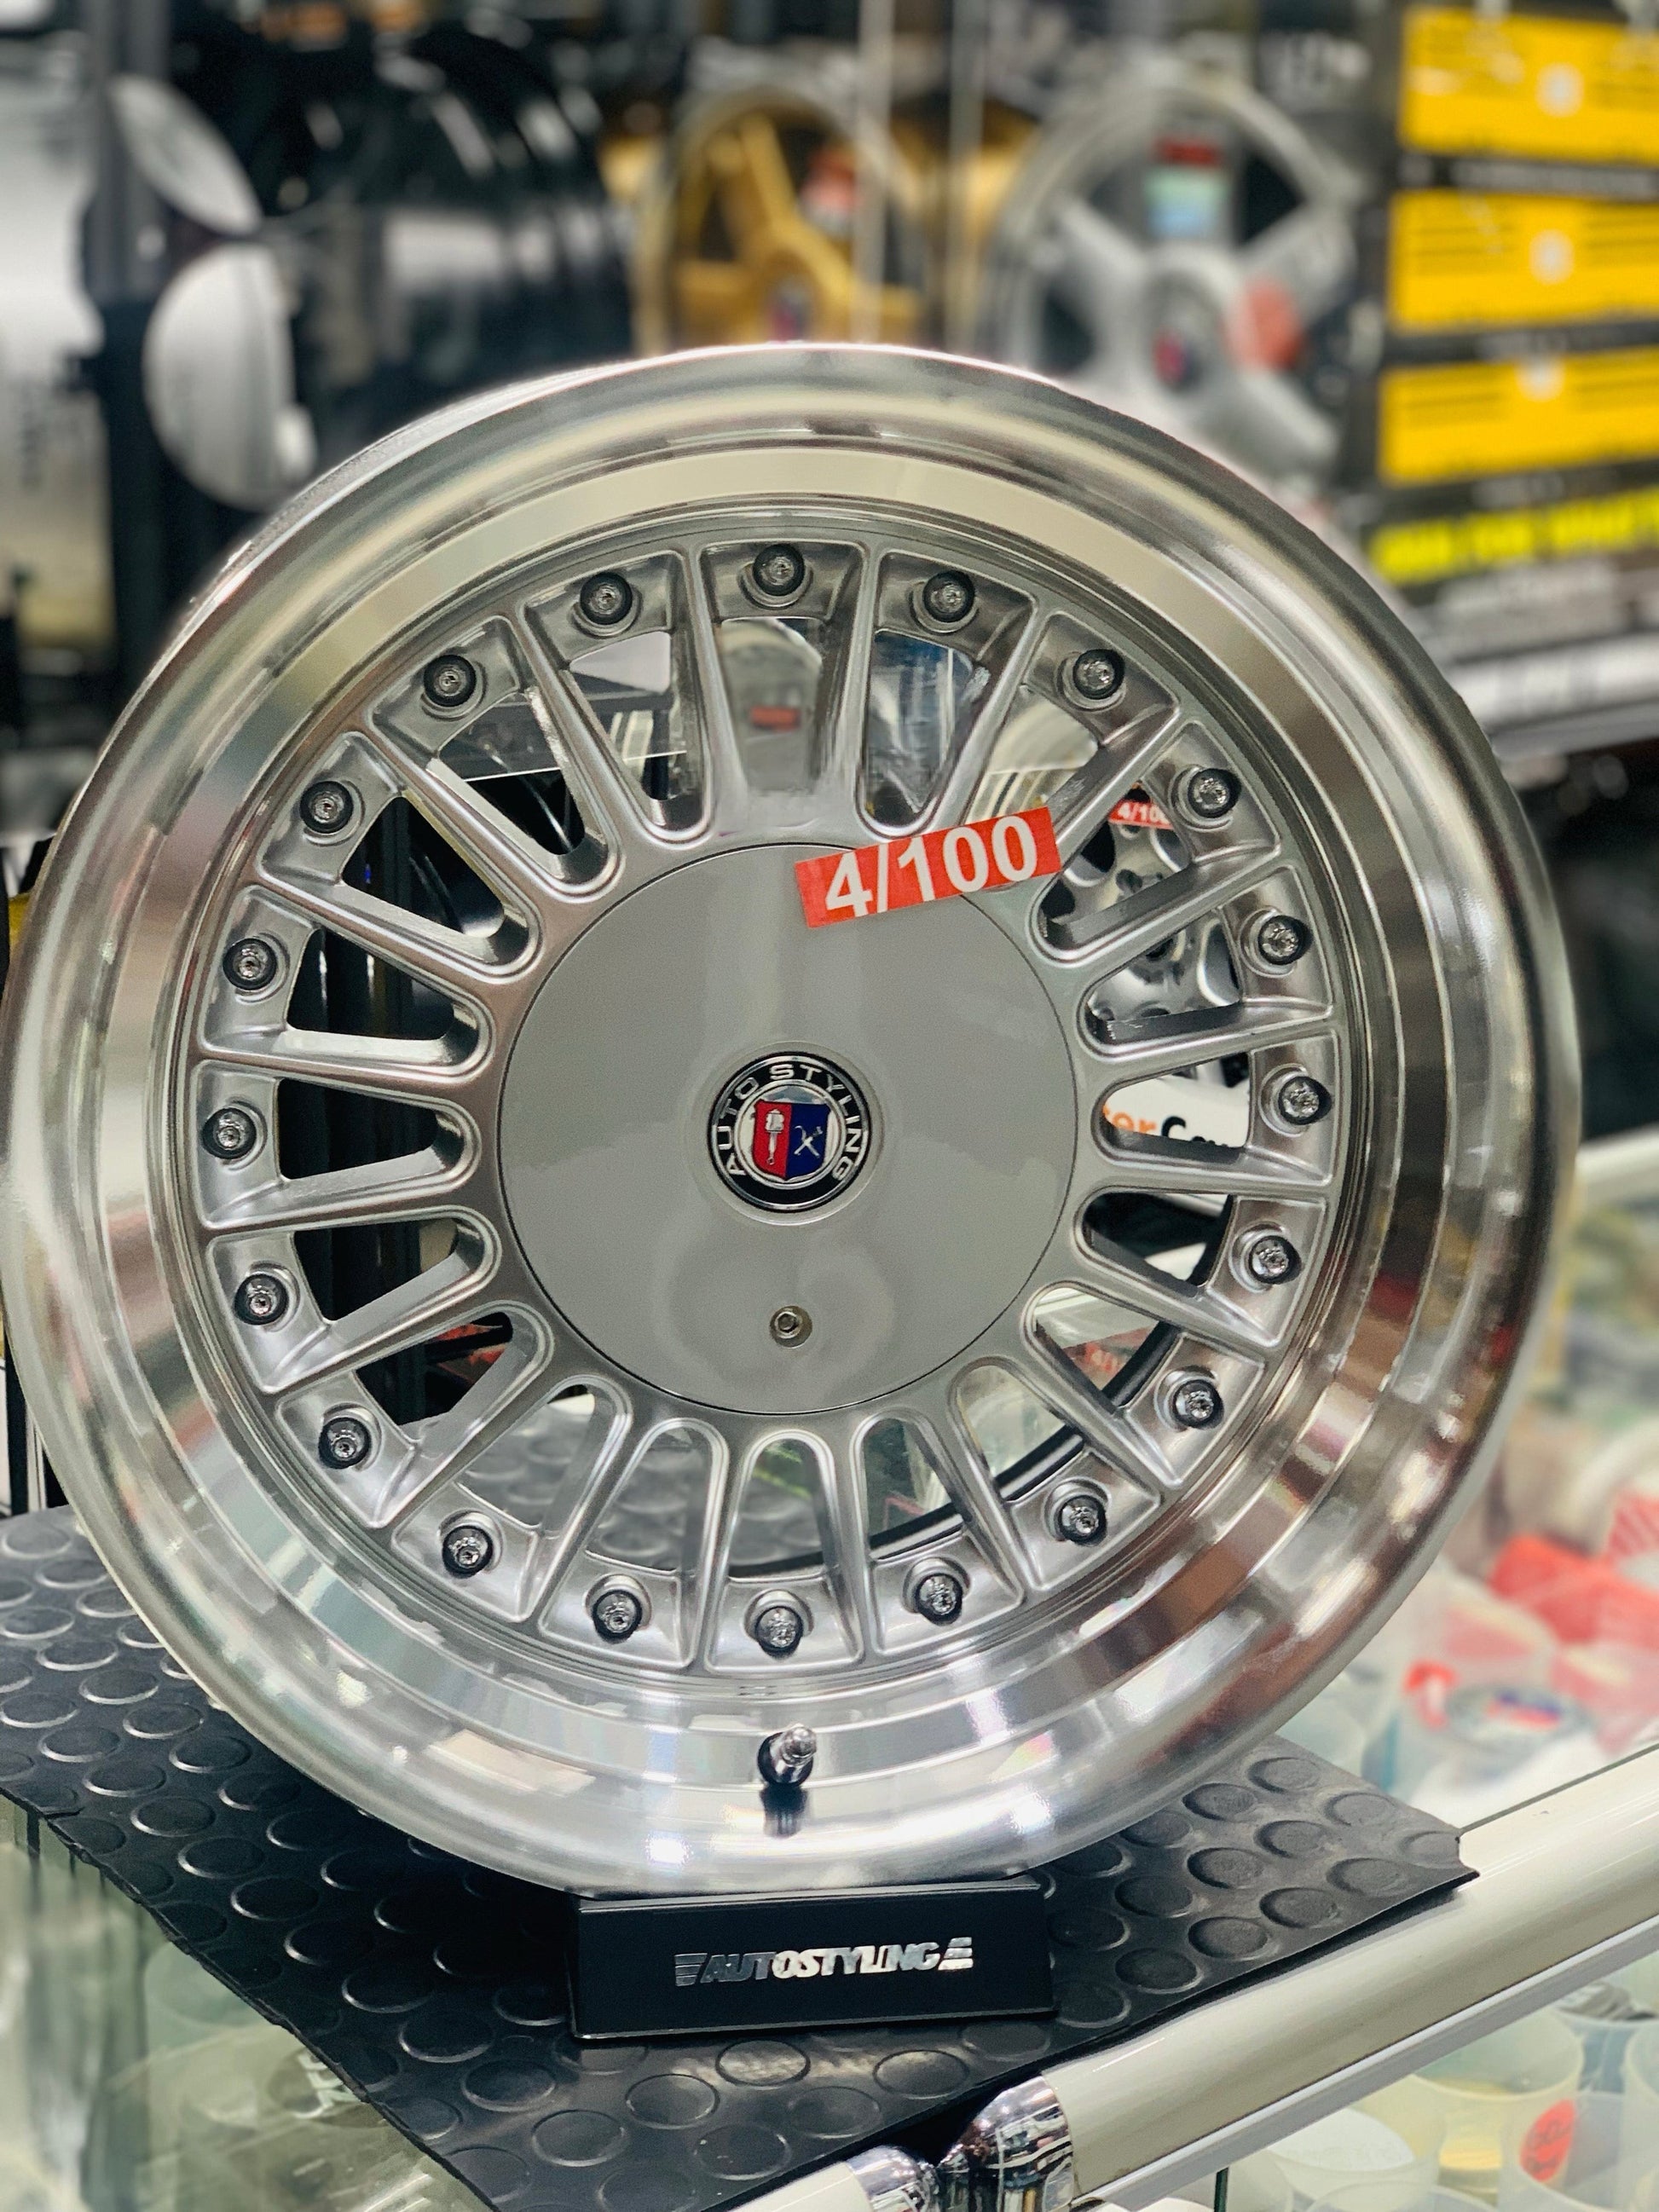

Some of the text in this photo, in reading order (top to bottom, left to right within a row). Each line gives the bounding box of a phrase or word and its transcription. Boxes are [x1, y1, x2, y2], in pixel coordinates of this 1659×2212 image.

[824, 816, 1038, 917] 4/100
[717, 1063, 862, 1181] AUTO STYLING
[700, 1941, 940, 1984] AUTOSTYLING
